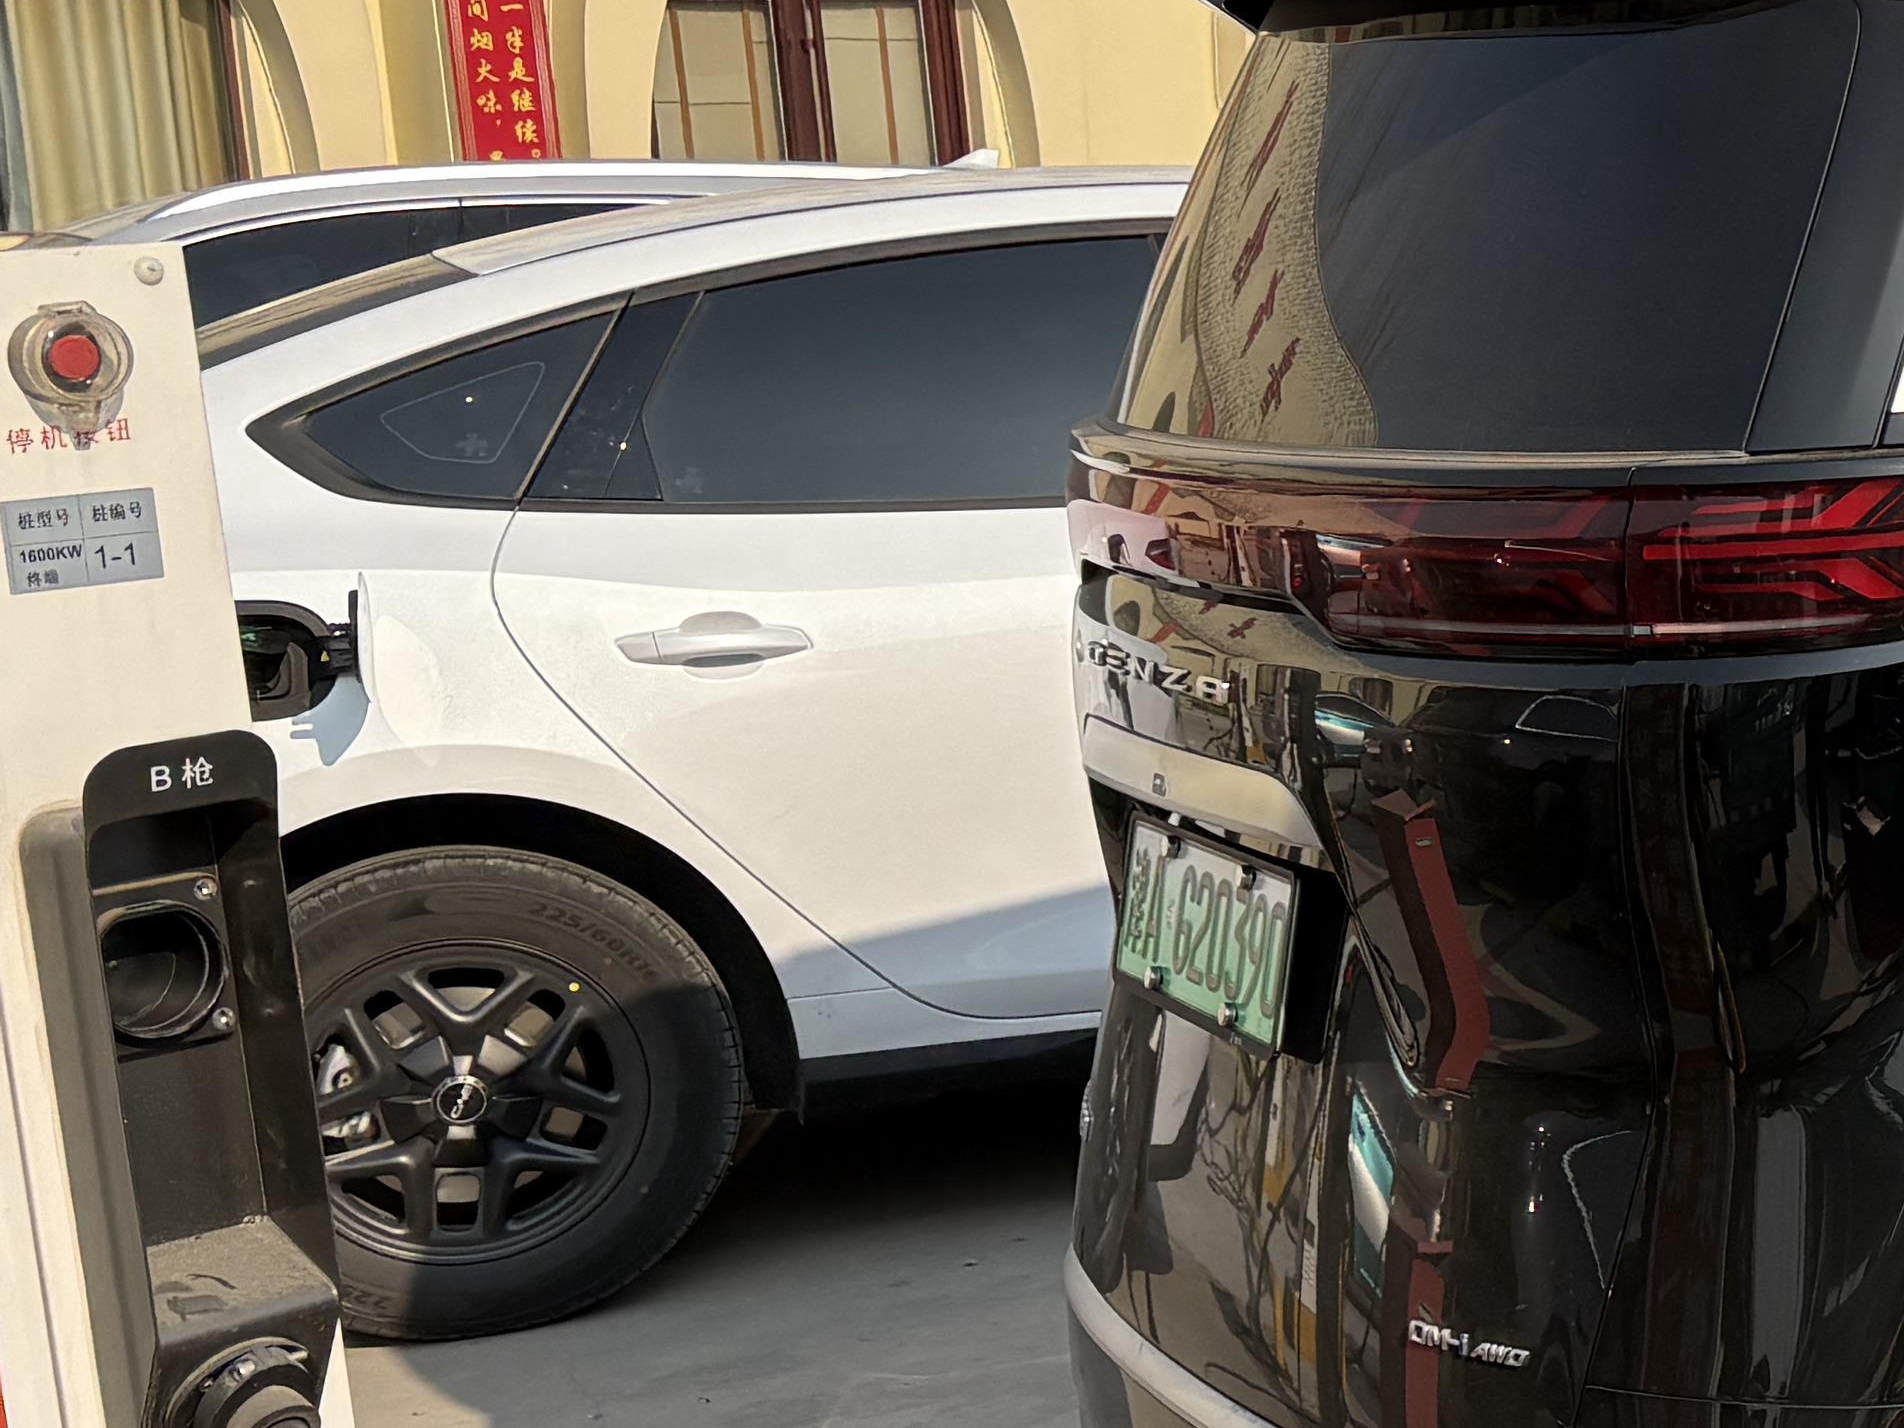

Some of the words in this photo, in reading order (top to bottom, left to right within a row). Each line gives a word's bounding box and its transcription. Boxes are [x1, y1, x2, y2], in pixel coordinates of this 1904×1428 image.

[18, 508, 69, 530] 桩型号
[92, 502, 142, 522] 桩编号
[19, 544, 82, 564] 1600KW
[95, 543, 136, 569] 1-1
[1471, 1342, 1530, 1367] AWD
